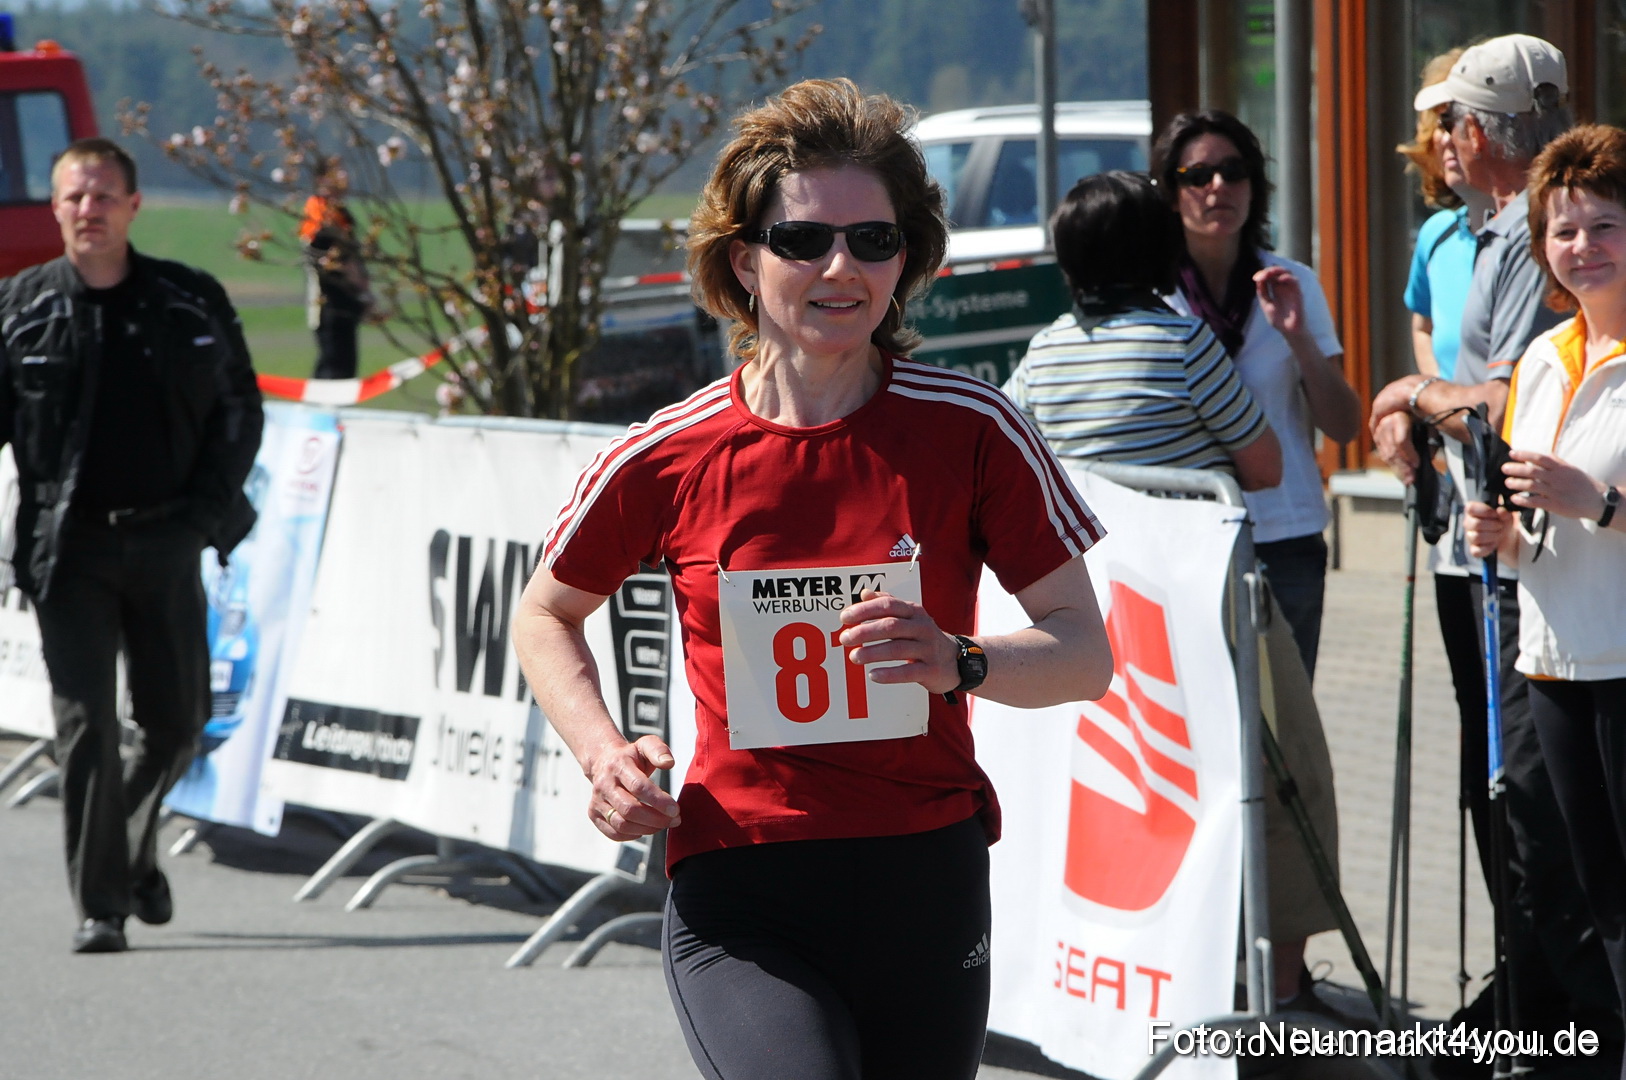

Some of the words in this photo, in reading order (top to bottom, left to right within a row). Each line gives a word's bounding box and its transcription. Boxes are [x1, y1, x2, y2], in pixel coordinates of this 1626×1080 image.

[889, 548, 922, 557] adid
[752, 576, 843, 599] MEYER
[753, 597, 845, 614] WERBUNG
[773, 622, 868, 723] 81
